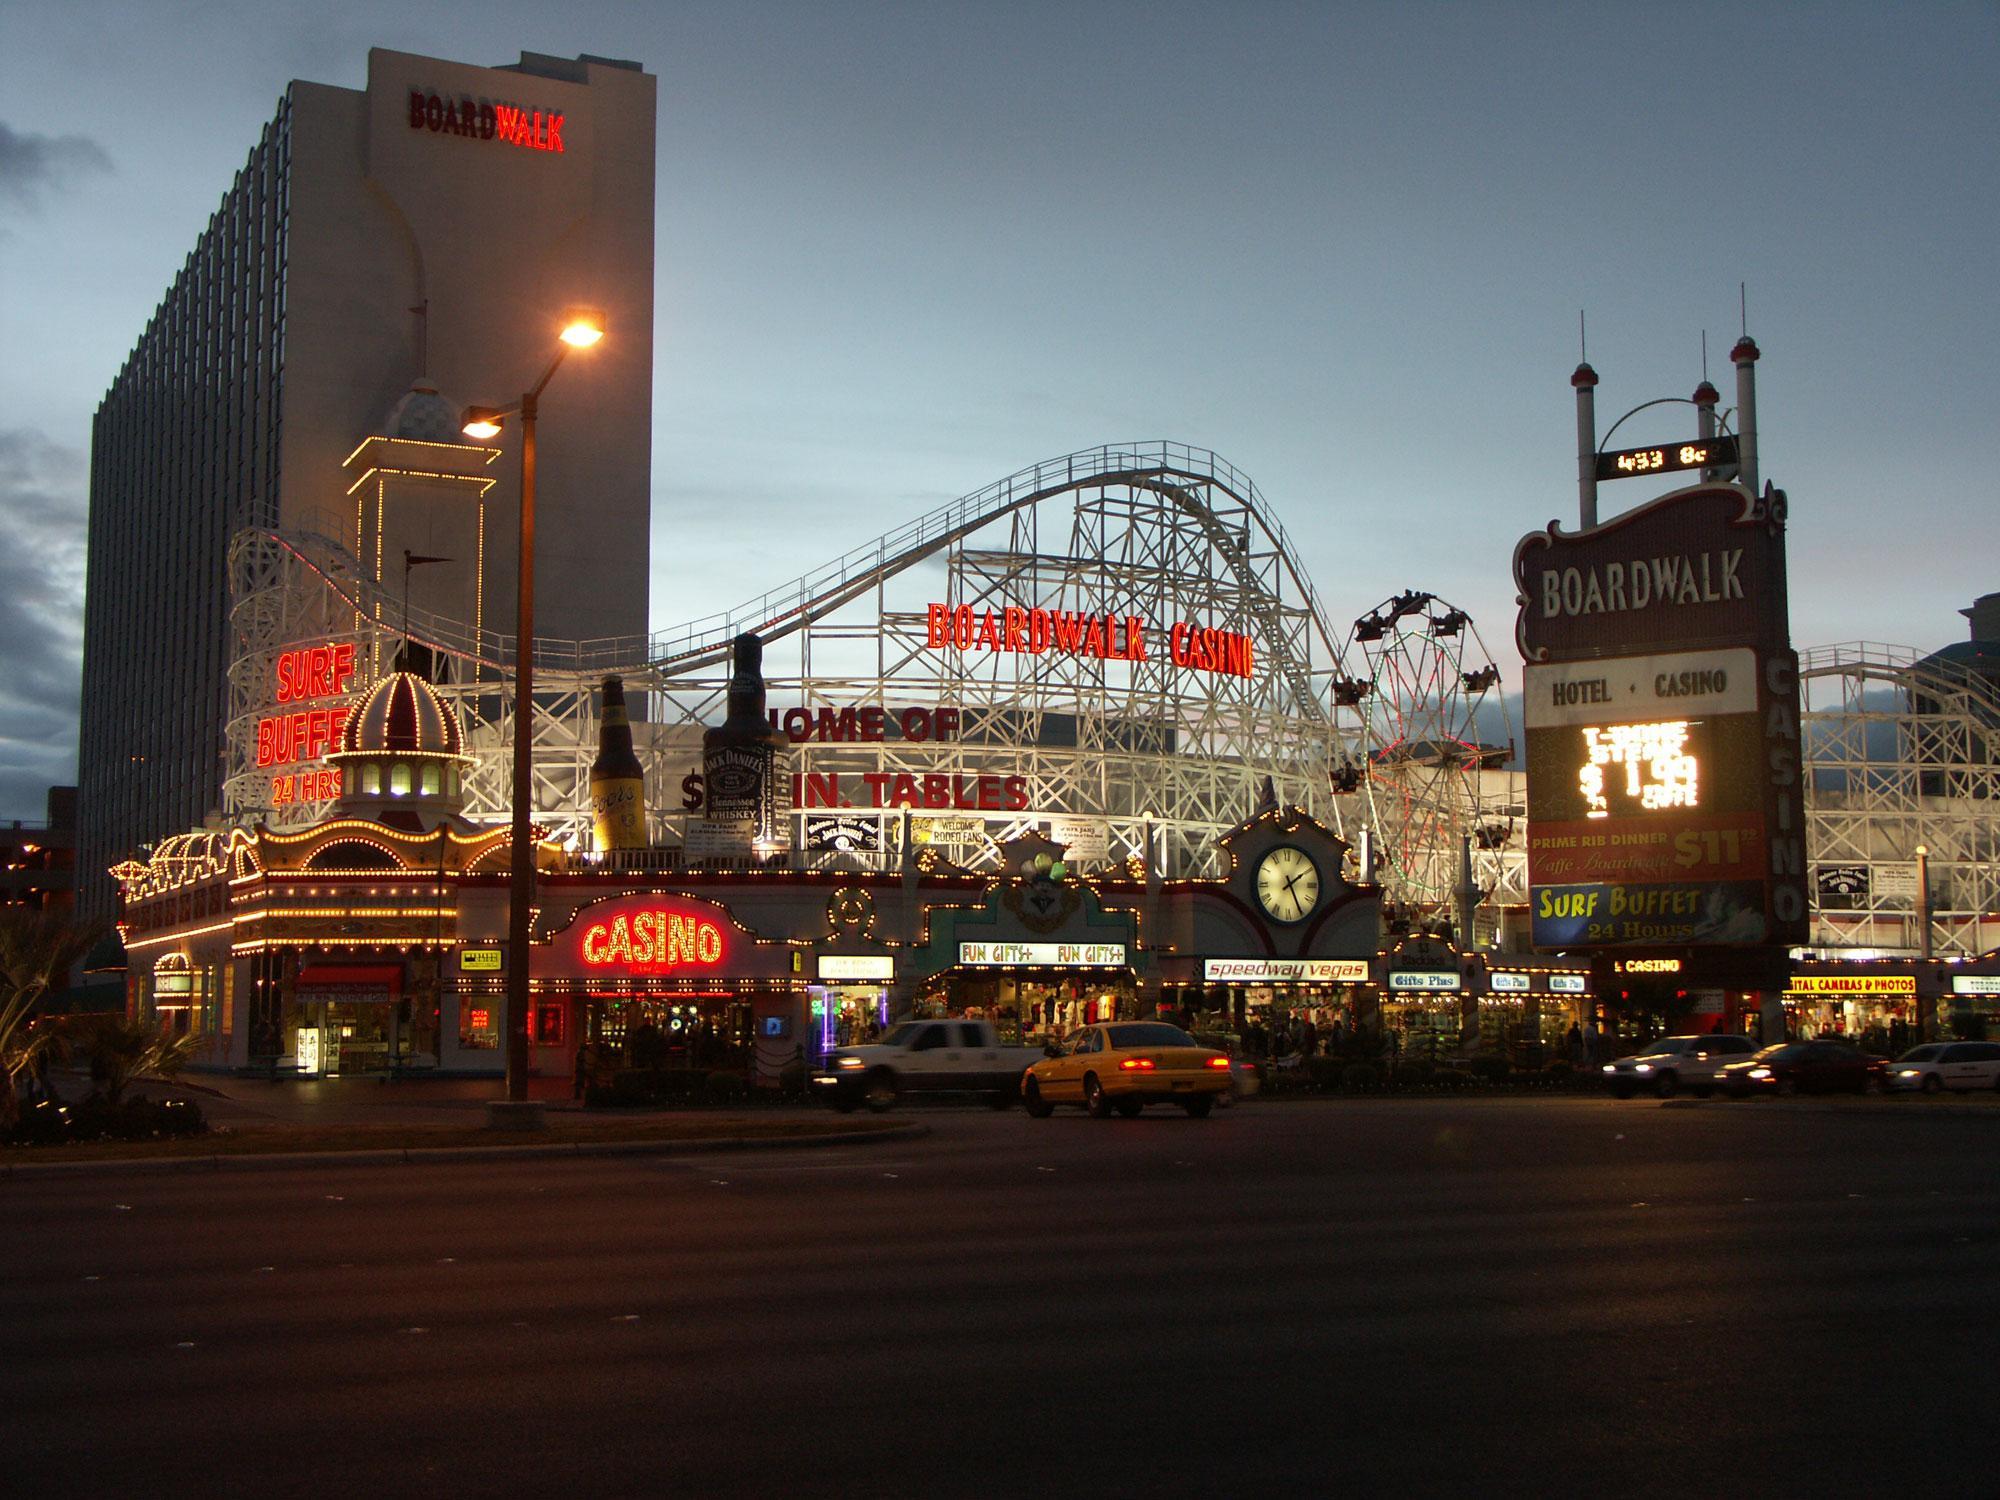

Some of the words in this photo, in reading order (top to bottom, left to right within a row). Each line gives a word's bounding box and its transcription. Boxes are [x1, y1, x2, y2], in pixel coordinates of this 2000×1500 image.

[410, 91, 565, 152] BOARDWALK
[1542, 549, 1744, 619] BOARDWALK
[927, 603, 1148, 661] BOARDWALK
[1169, 621, 1254, 679] CASINO
[277, 643, 355, 702] SURF
[1552, 679, 1612, 706] HOTEL
[1655, 669, 1727, 698] CASINO
[902, 706, 960, 743] OF
[257, 709, 352, 768] BUFFE
[704, 756, 725, 774] JACK
[272, 775, 295, 806] 24
[301, 768, 343, 801] HRS
[864, 773, 1028, 810] TABLES
[1765, 656, 1801, 922] CASINO
[709, 810, 757, 819] WHISKEY
[941, 822, 976, 831] WELCOME
[934, 831, 962, 843] RODEO
[963, 832, 983, 843] FANS
[1532, 836, 1577, 850] PRIME
[1582, 835, 1606, 848] RIB
[1611, 832, 1668, 847] DINNER
[1539, 889, 1598, 919] SURF
[1609, 886, 1701, 916] BUFFET
[582, 911, 722, 965] CASINO
[1588, 923, 1616, 939] 24
[1622, 921, 1696, 939] Hours
[962, 944, 987, 962] FUN
[992, 945, 1033, 962] GIFTS+
[1058, 945, 1080, 962] FUN
[1085, 946, 1123, 963] GIFTS+
[1209, 962, 1305, 979] speedway
[1309, 964, 1364, 979] vegas
[1625, 960, 1681, 972] CASINO
[1395, 975, 1424, 986] Gifts
[1428, 975, 1453, 986] Plus
[1790, 980, 1814, 991] ITAL
[1818, 980, 1862, 991] CAMERAS
[1874, 980, 1914, 991] PHOTOS
